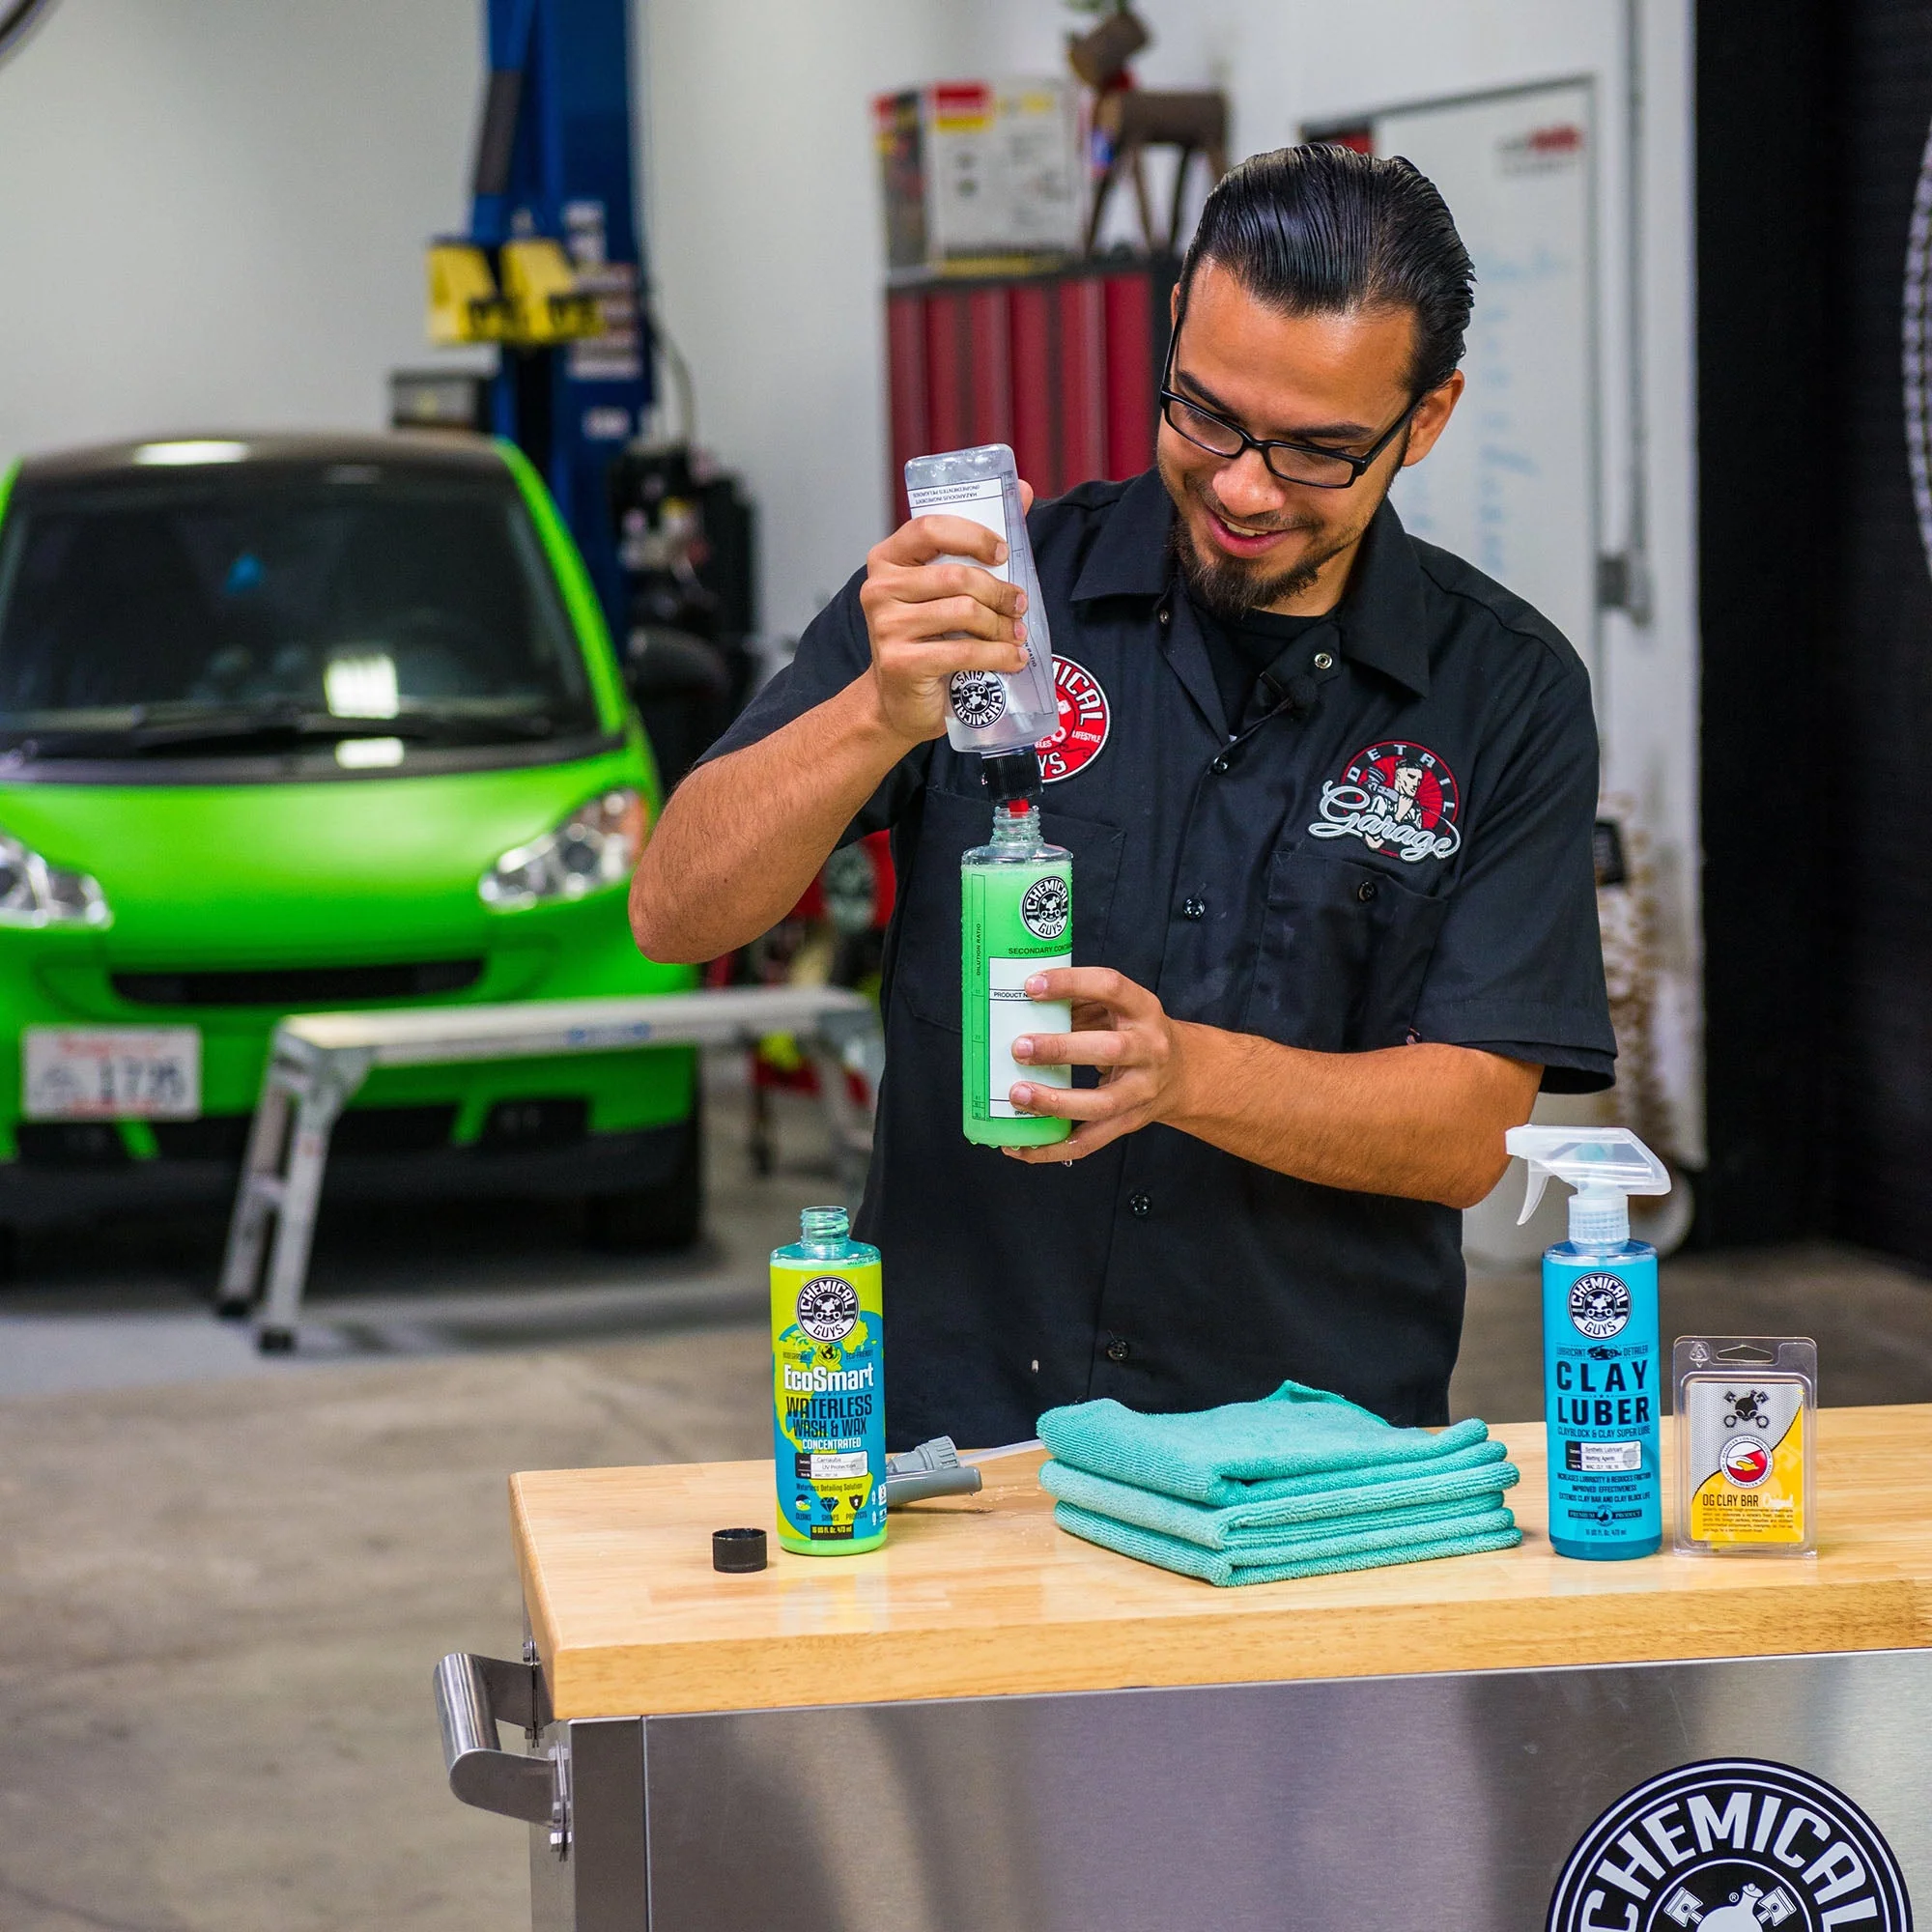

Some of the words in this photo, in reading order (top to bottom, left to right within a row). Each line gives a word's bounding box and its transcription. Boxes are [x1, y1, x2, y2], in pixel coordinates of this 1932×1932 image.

[954, 691, 1003, 725] CHEMICAL
[1071, 729, 1102, 744] LIFESTYLE
[1037, 752, 1067, 778] YS
[1347, 744, 1456, 813] DETAIL
[1308, 780, 1462, 863] Garage
[1026, 879, 1068, 910] CHEMICAL
[1037, 921, 1063, 936] GUYS
[1009, 947, 1052, 955] SECONDARY
[800, 1280, 856, 1311] CHEMICAL
[1571, 1276, 1630, 1307] CHEMICAL
[813, 1323, 844, 1339] GUYS
[1584, 1321, 1617, 1336] GUYS
[783, 1361, 874, 1392] EcoSmart
[1556, 1359, 1648, 1393] CLAY
[785, 1394, 873, 1419] WATERLESS
[1557, 1396, 1650, 1427] LUBER
[793, 1418, 828, 1437] WASH
[831, 1419, 838, 1437] &
[841, 1417, 867, 1436] WAX
[1598, 1430, 1616, 1439] CLAY
[1617, 1428, 1638, 1438] SUPER
[802, 1436, 862, 1450] CONCENTRATED
[1703, 1493, 1715, 1506] OG
[1717, 1494, 1738, 1507] CLAY
[1741, 1494, 1759, 1507] BAR
[1580, 1791, 1878, 1932] CHEMICAL
